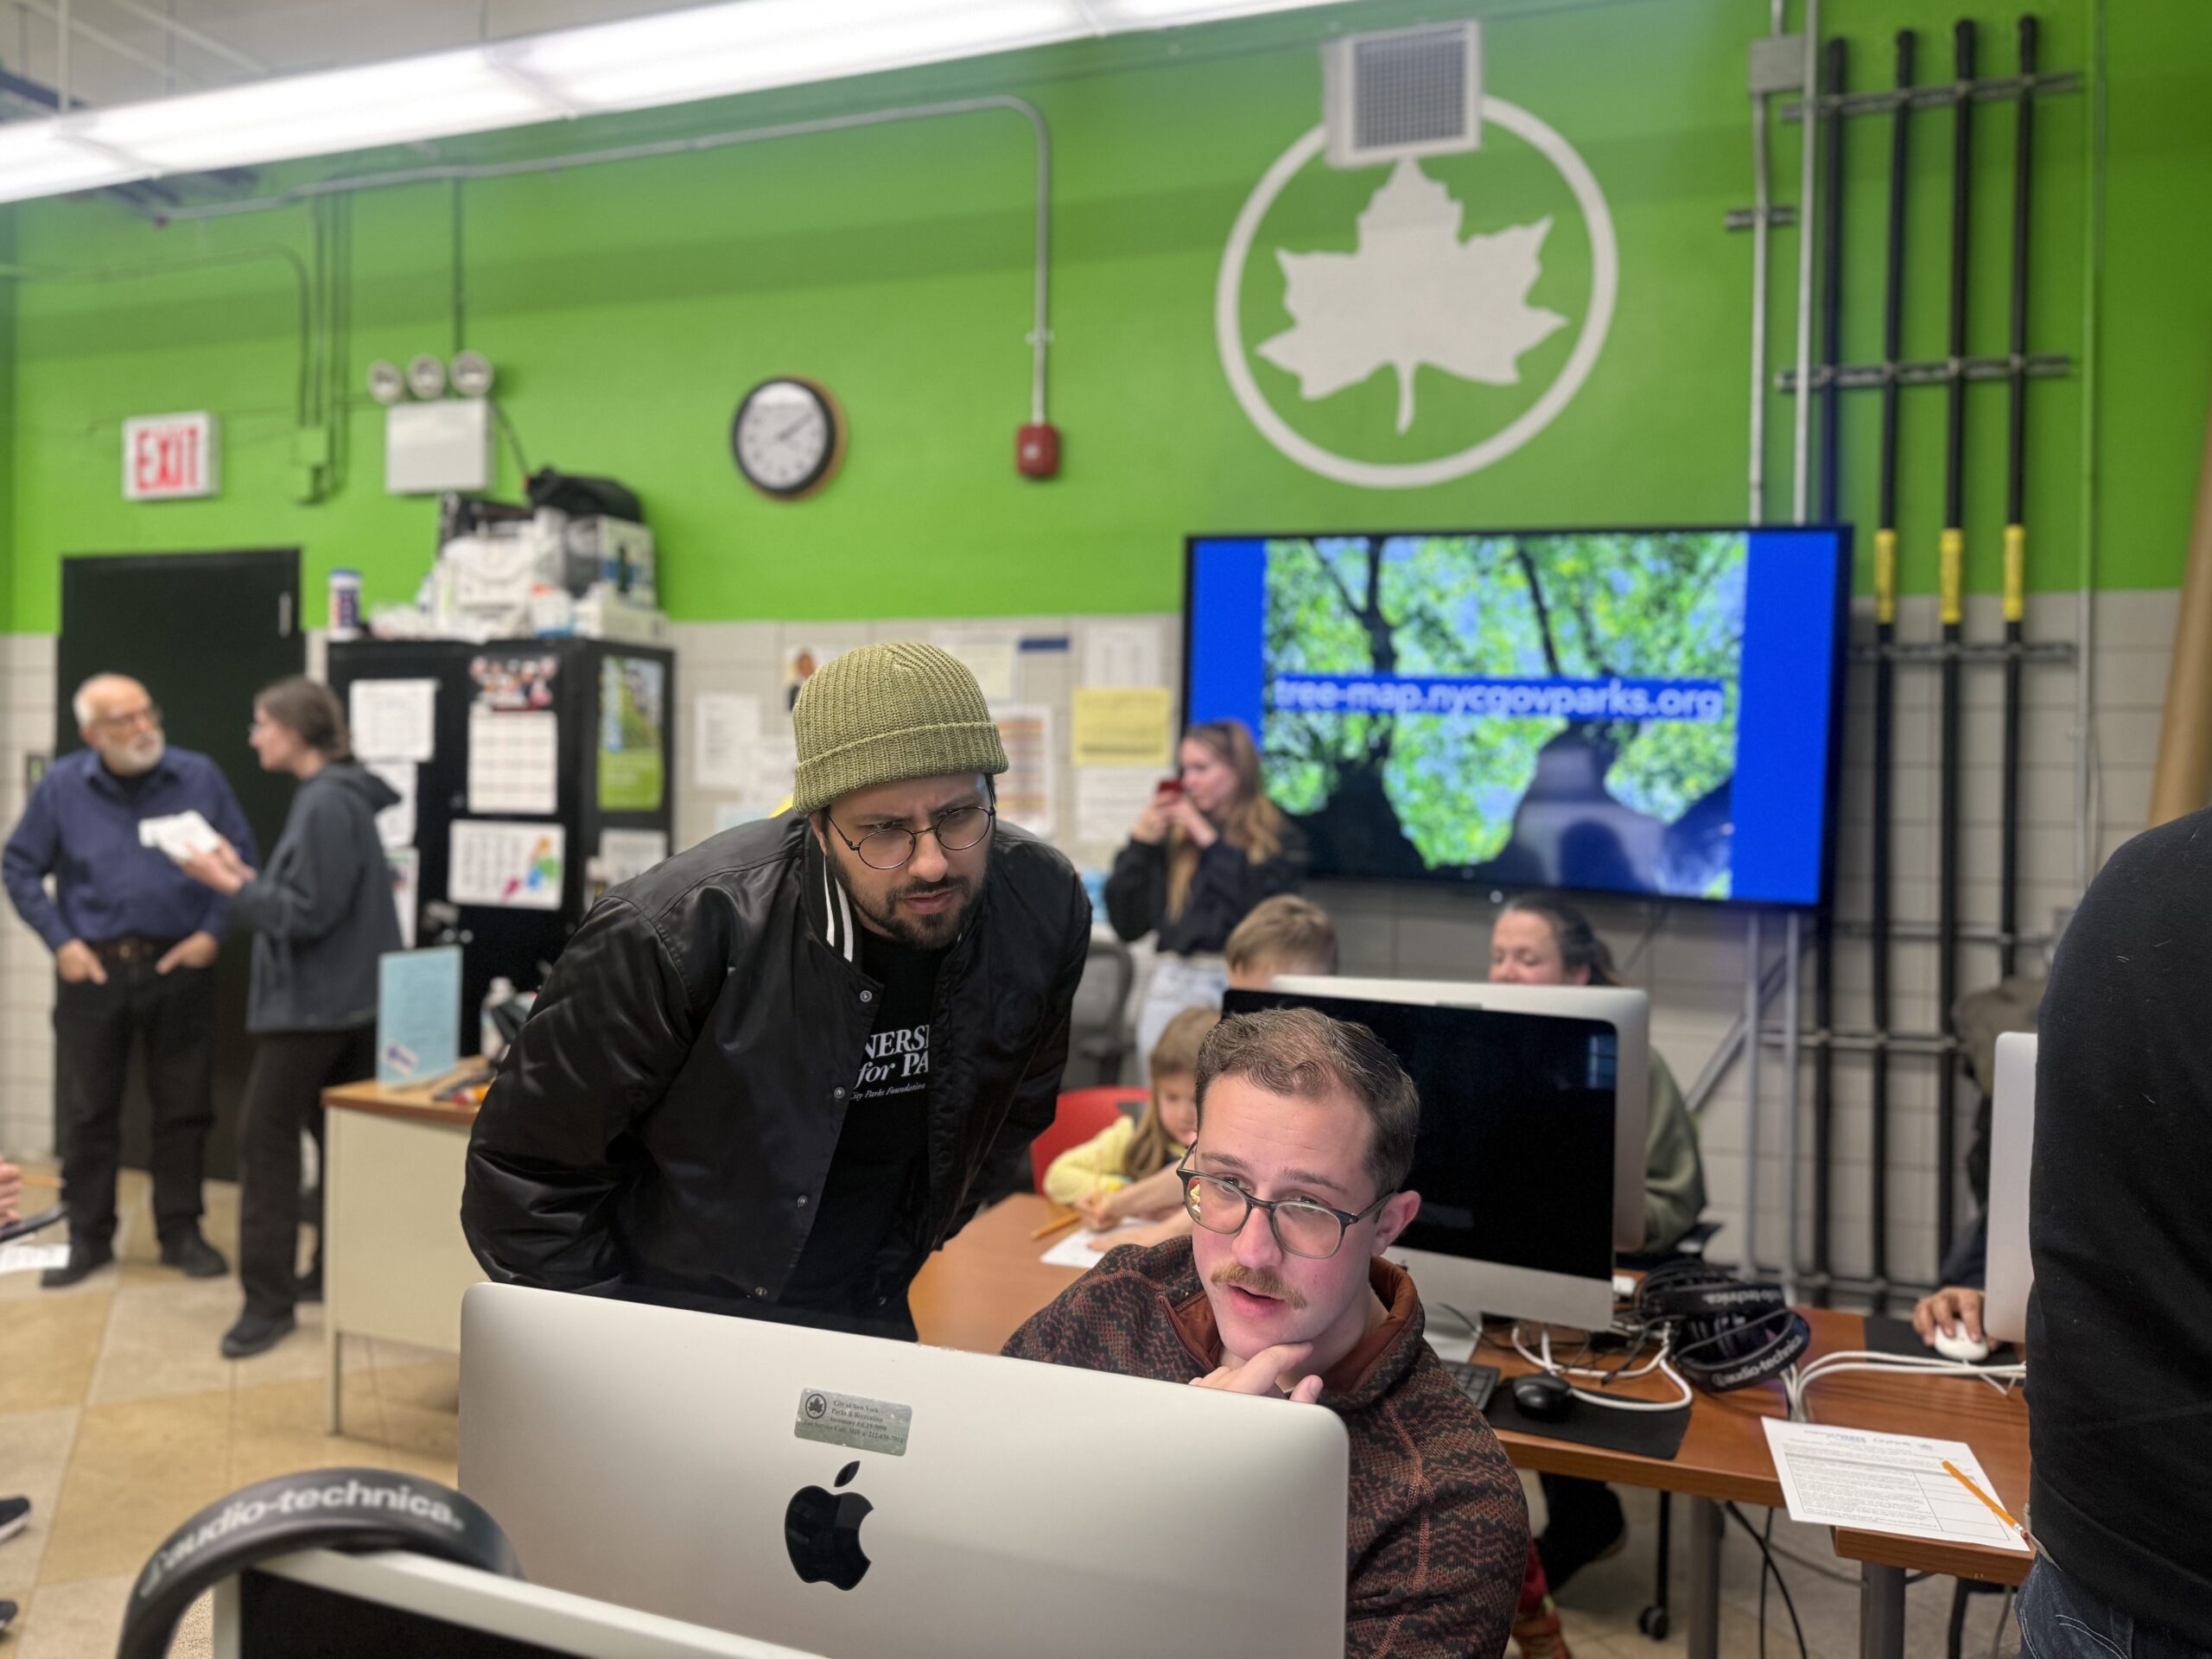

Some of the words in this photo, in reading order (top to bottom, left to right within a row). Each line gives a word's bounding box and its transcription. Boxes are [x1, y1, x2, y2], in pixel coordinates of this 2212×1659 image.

[136, 424, 200, 492] EXIT
[1274, 678, 1723, 721] tree-map.nycgovparks.org
[853, 1061, 896, 1090] for
[865, 1089, 885, 1098] Parks
[886, 1082, 926, 1096] Foundation
[1724, 1334, 1803, 1384] audio-technica
[831, 1408, 847, 1416] Parks
[855, 1411, 883, 1423] Recreation
[833, 1400, 844, 1408] City
[865, 1405, 878, 1414] York
[165, 1479, 453, 1570] audio-technica
